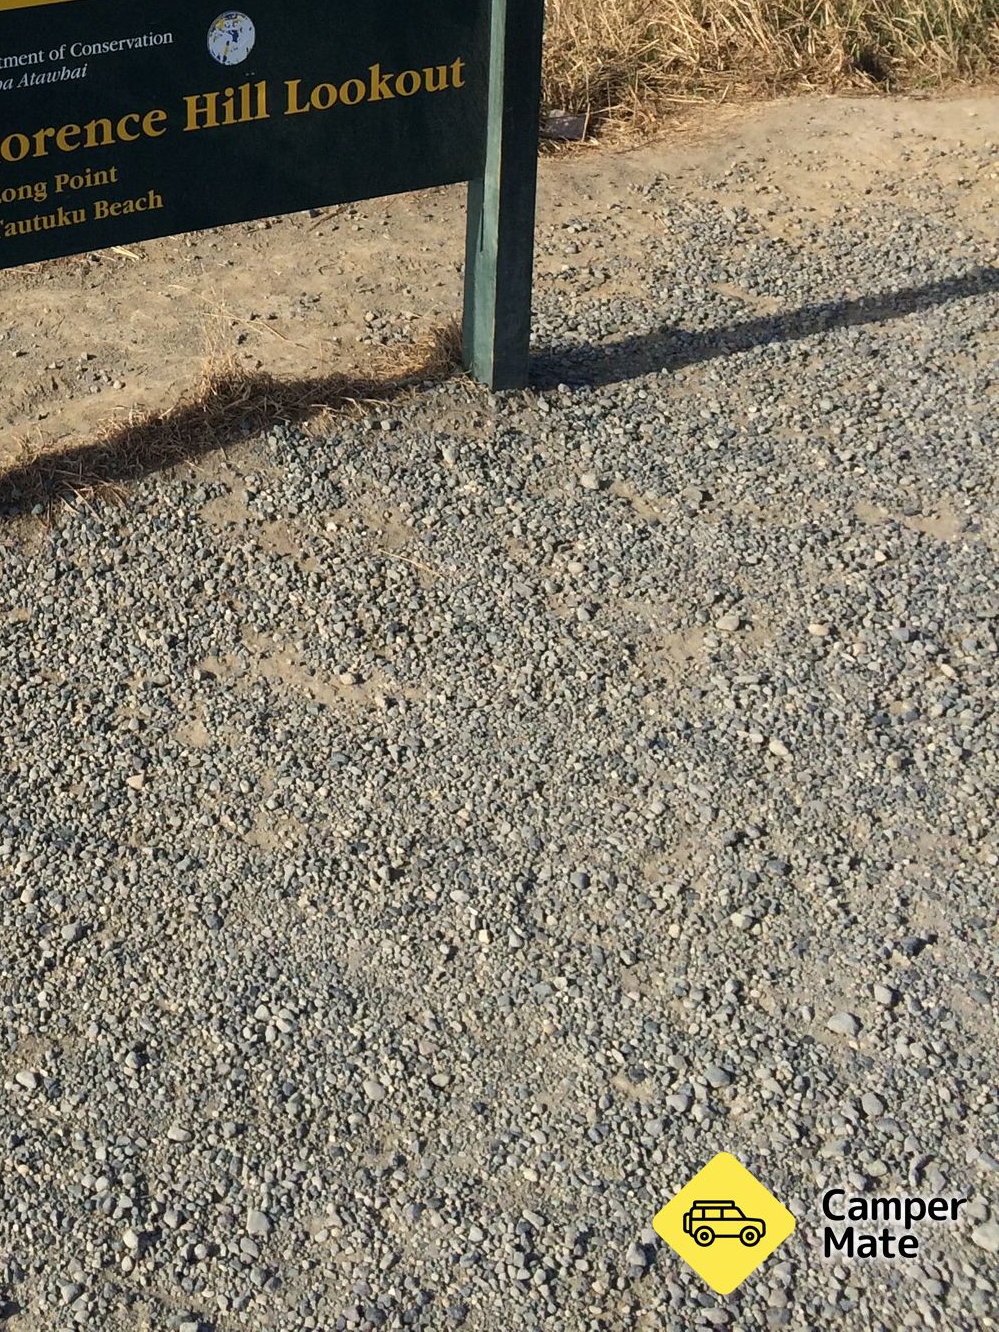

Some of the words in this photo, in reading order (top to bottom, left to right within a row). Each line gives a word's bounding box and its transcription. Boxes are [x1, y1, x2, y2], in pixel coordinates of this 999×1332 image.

[49, 45, 66, 61] of
[70, 32, 173, 57] Conservation
[17, 63, 88, 88] Atawhai
[183, 80, 270, 131] Hill
[284, 56, 465, 115] Lookout
[55, 166, 117, 193] Point
[94, 190, 163, 220] Beach
